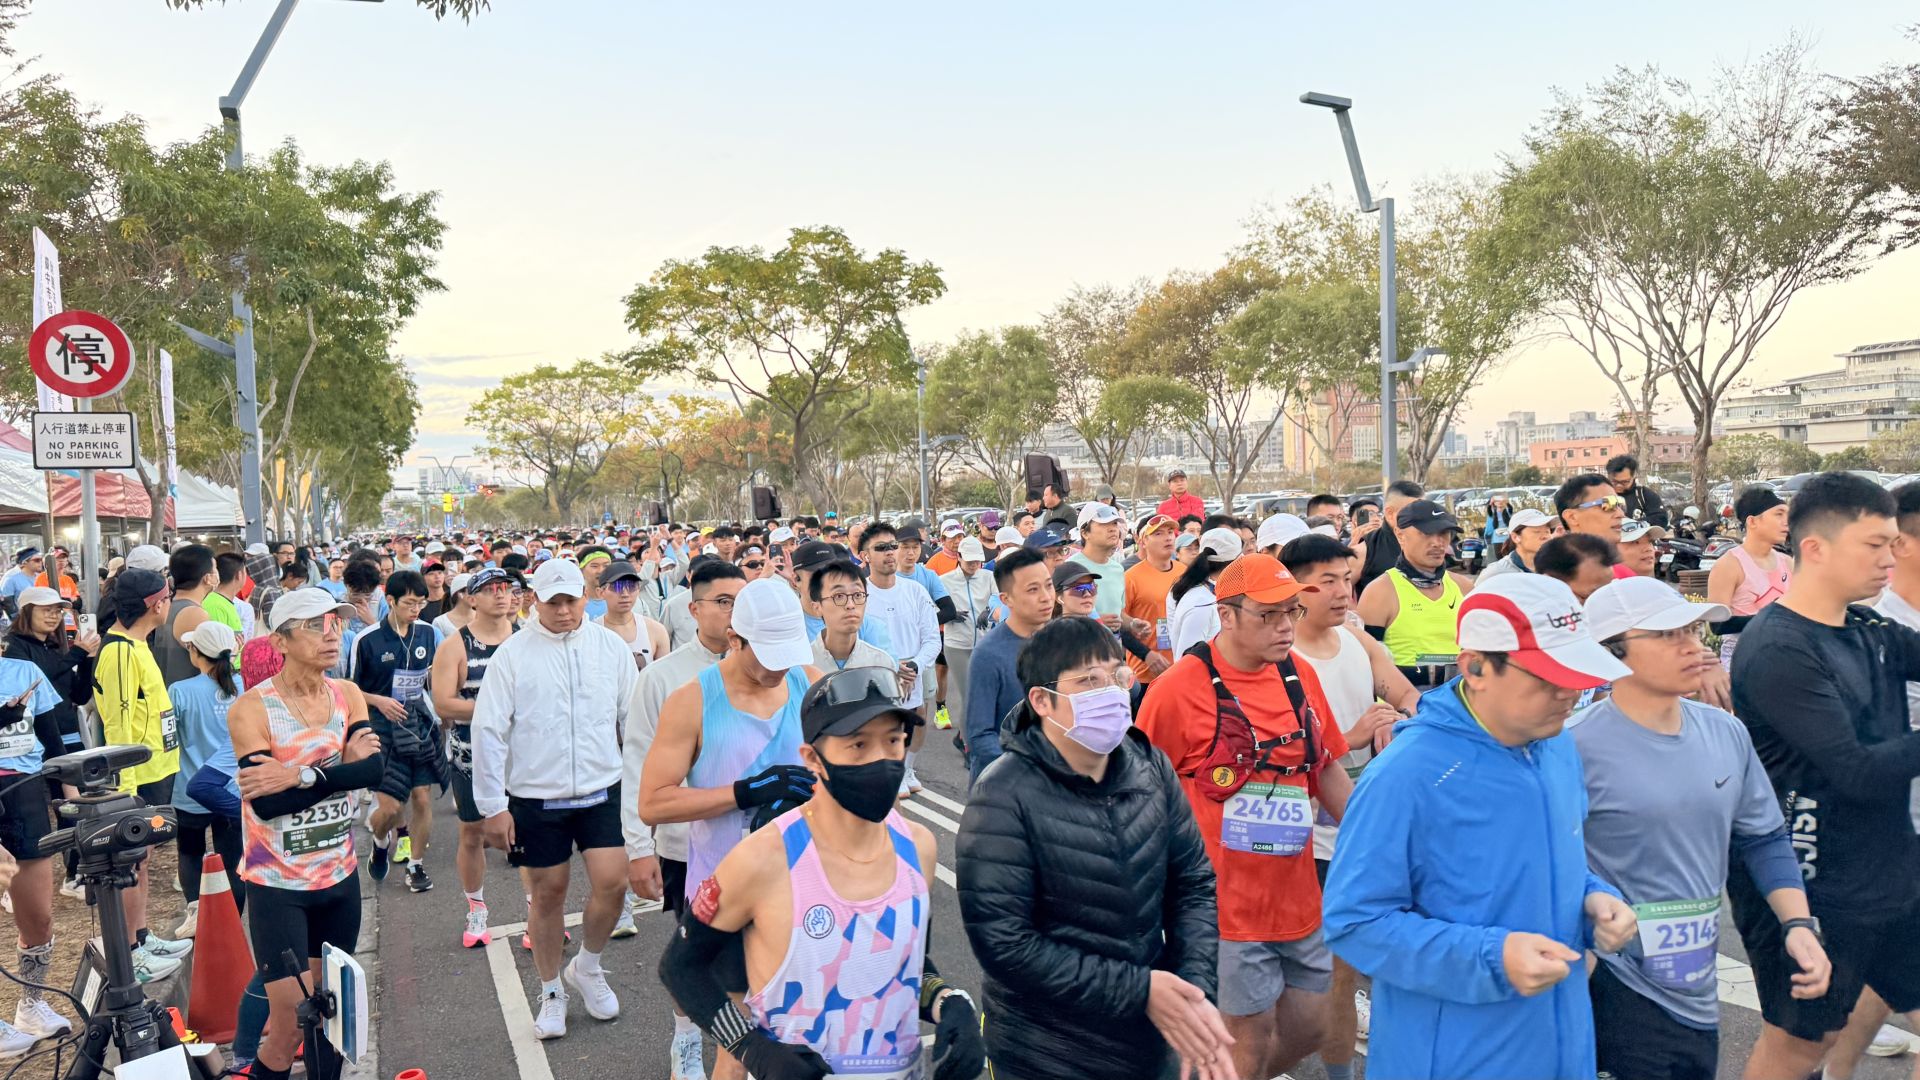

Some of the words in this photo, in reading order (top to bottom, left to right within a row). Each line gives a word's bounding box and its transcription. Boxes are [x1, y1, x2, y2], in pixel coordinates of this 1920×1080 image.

[56, 332, 106, 376] 停
[40, 422, 127, 435] 人行道禁止停車
[46, 451, 62, 460] ON
[66, 450, 122, 460] SIDEWALK
[49, 441, 65, 450] NO
[70, 441, 119, 450] PARKING
[290, 800, 349, 827] 52330
[1233, 797, 1304, 823] 24765
